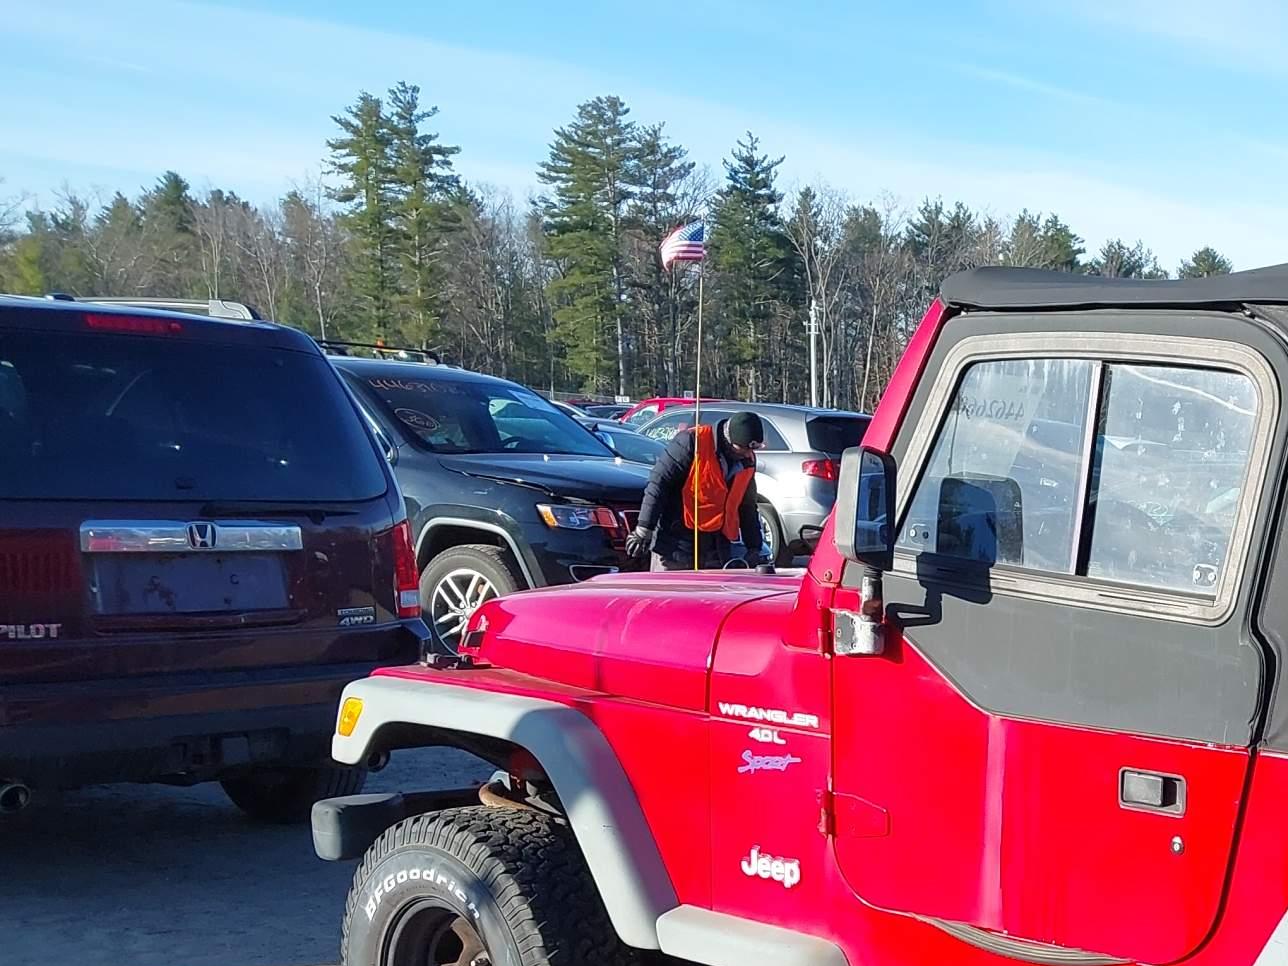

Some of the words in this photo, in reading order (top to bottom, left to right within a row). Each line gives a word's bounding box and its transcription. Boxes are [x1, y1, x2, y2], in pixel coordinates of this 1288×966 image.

[718, 702, 820, 729] WRANGLER
[737, 749, 802, 774] Sport
[741, 845, 801, 888] Jeep
[364, 868, 481, 921] BFGoodrich
